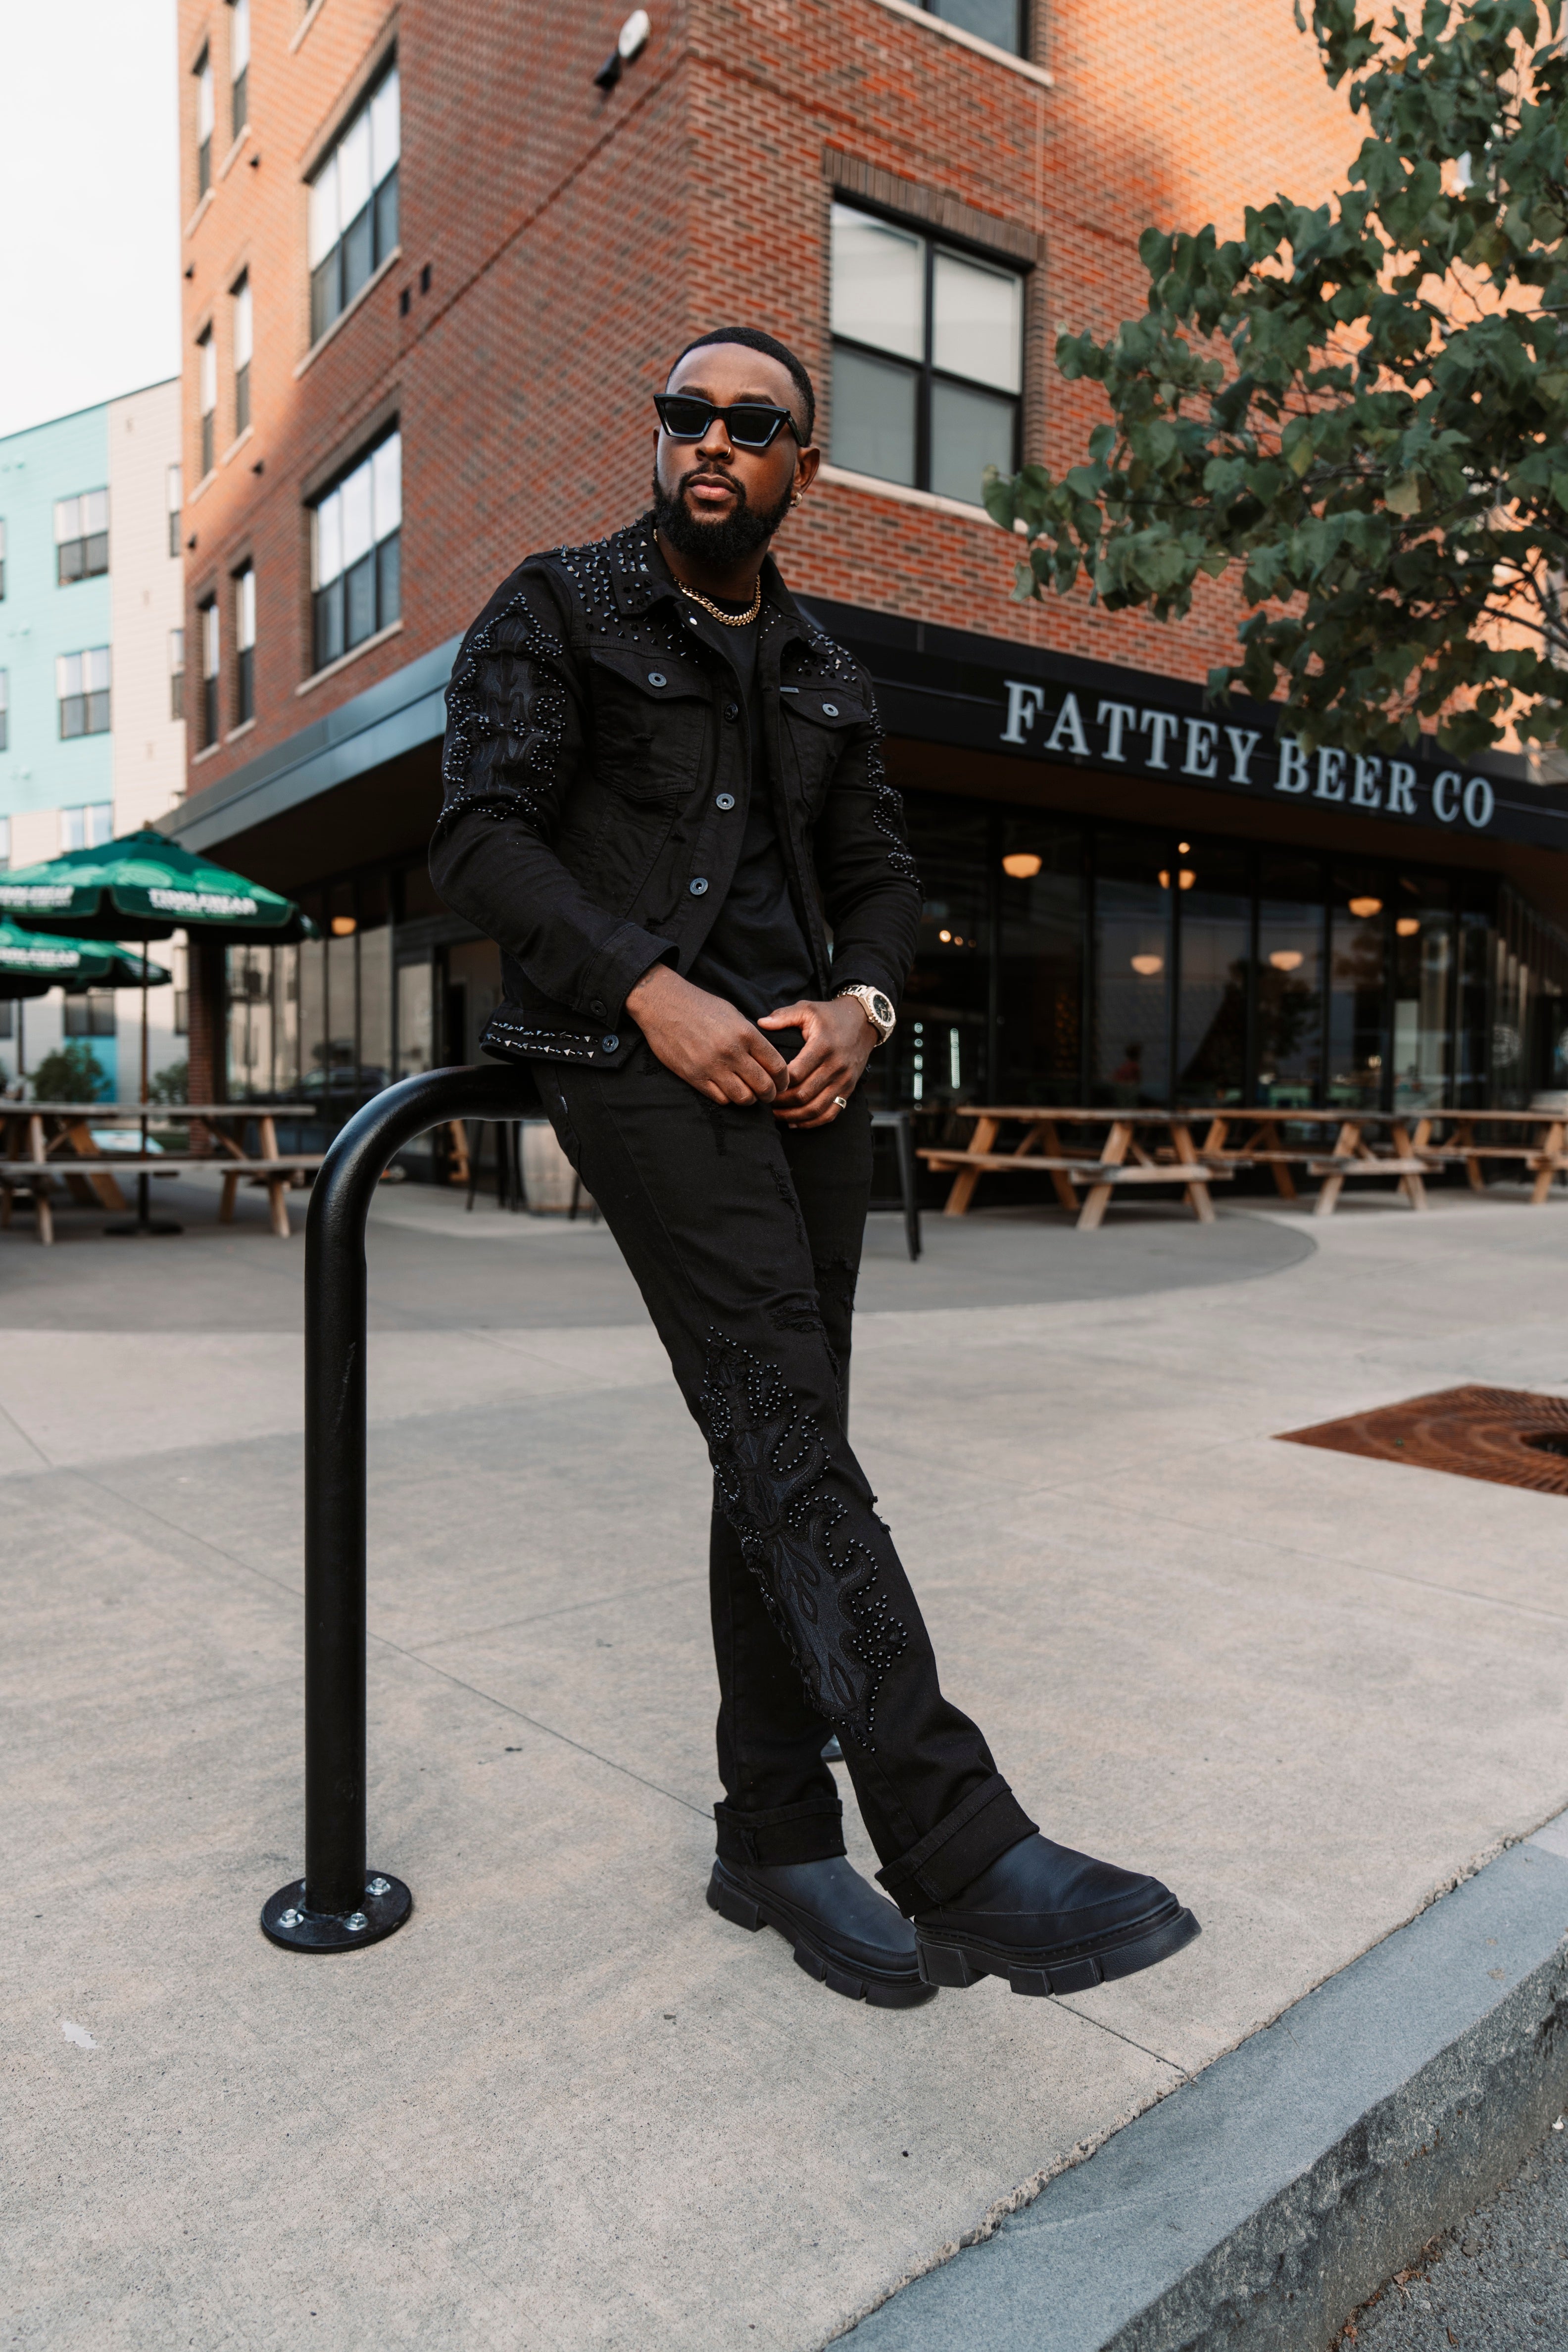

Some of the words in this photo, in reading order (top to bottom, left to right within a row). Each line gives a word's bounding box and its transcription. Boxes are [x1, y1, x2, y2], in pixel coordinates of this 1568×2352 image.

[999, 680, 1262, 785] FATTEY
[1274, 736, 1418, 815] BEER
[1432, 770, 1495, 829] CO
